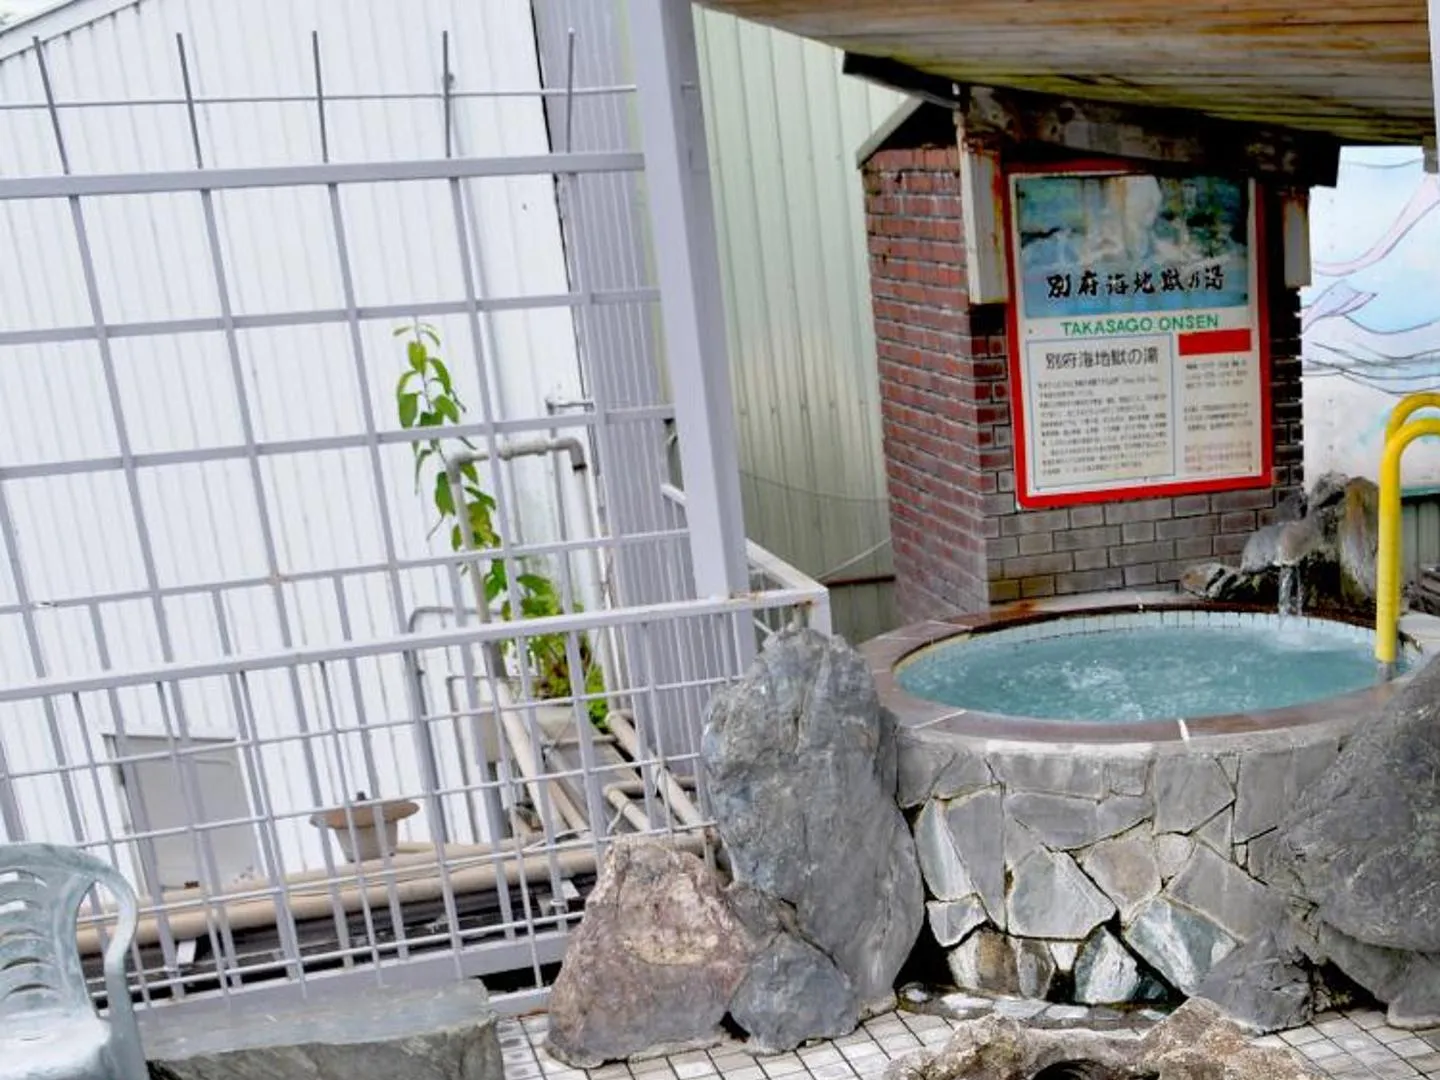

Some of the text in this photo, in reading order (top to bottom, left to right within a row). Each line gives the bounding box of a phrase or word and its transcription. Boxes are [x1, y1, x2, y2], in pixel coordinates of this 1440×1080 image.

[1060, 314, 1219, 336] TAKASAGO ONSEN
[1045, 346, 1159, 370] 別府海地獄の湯
